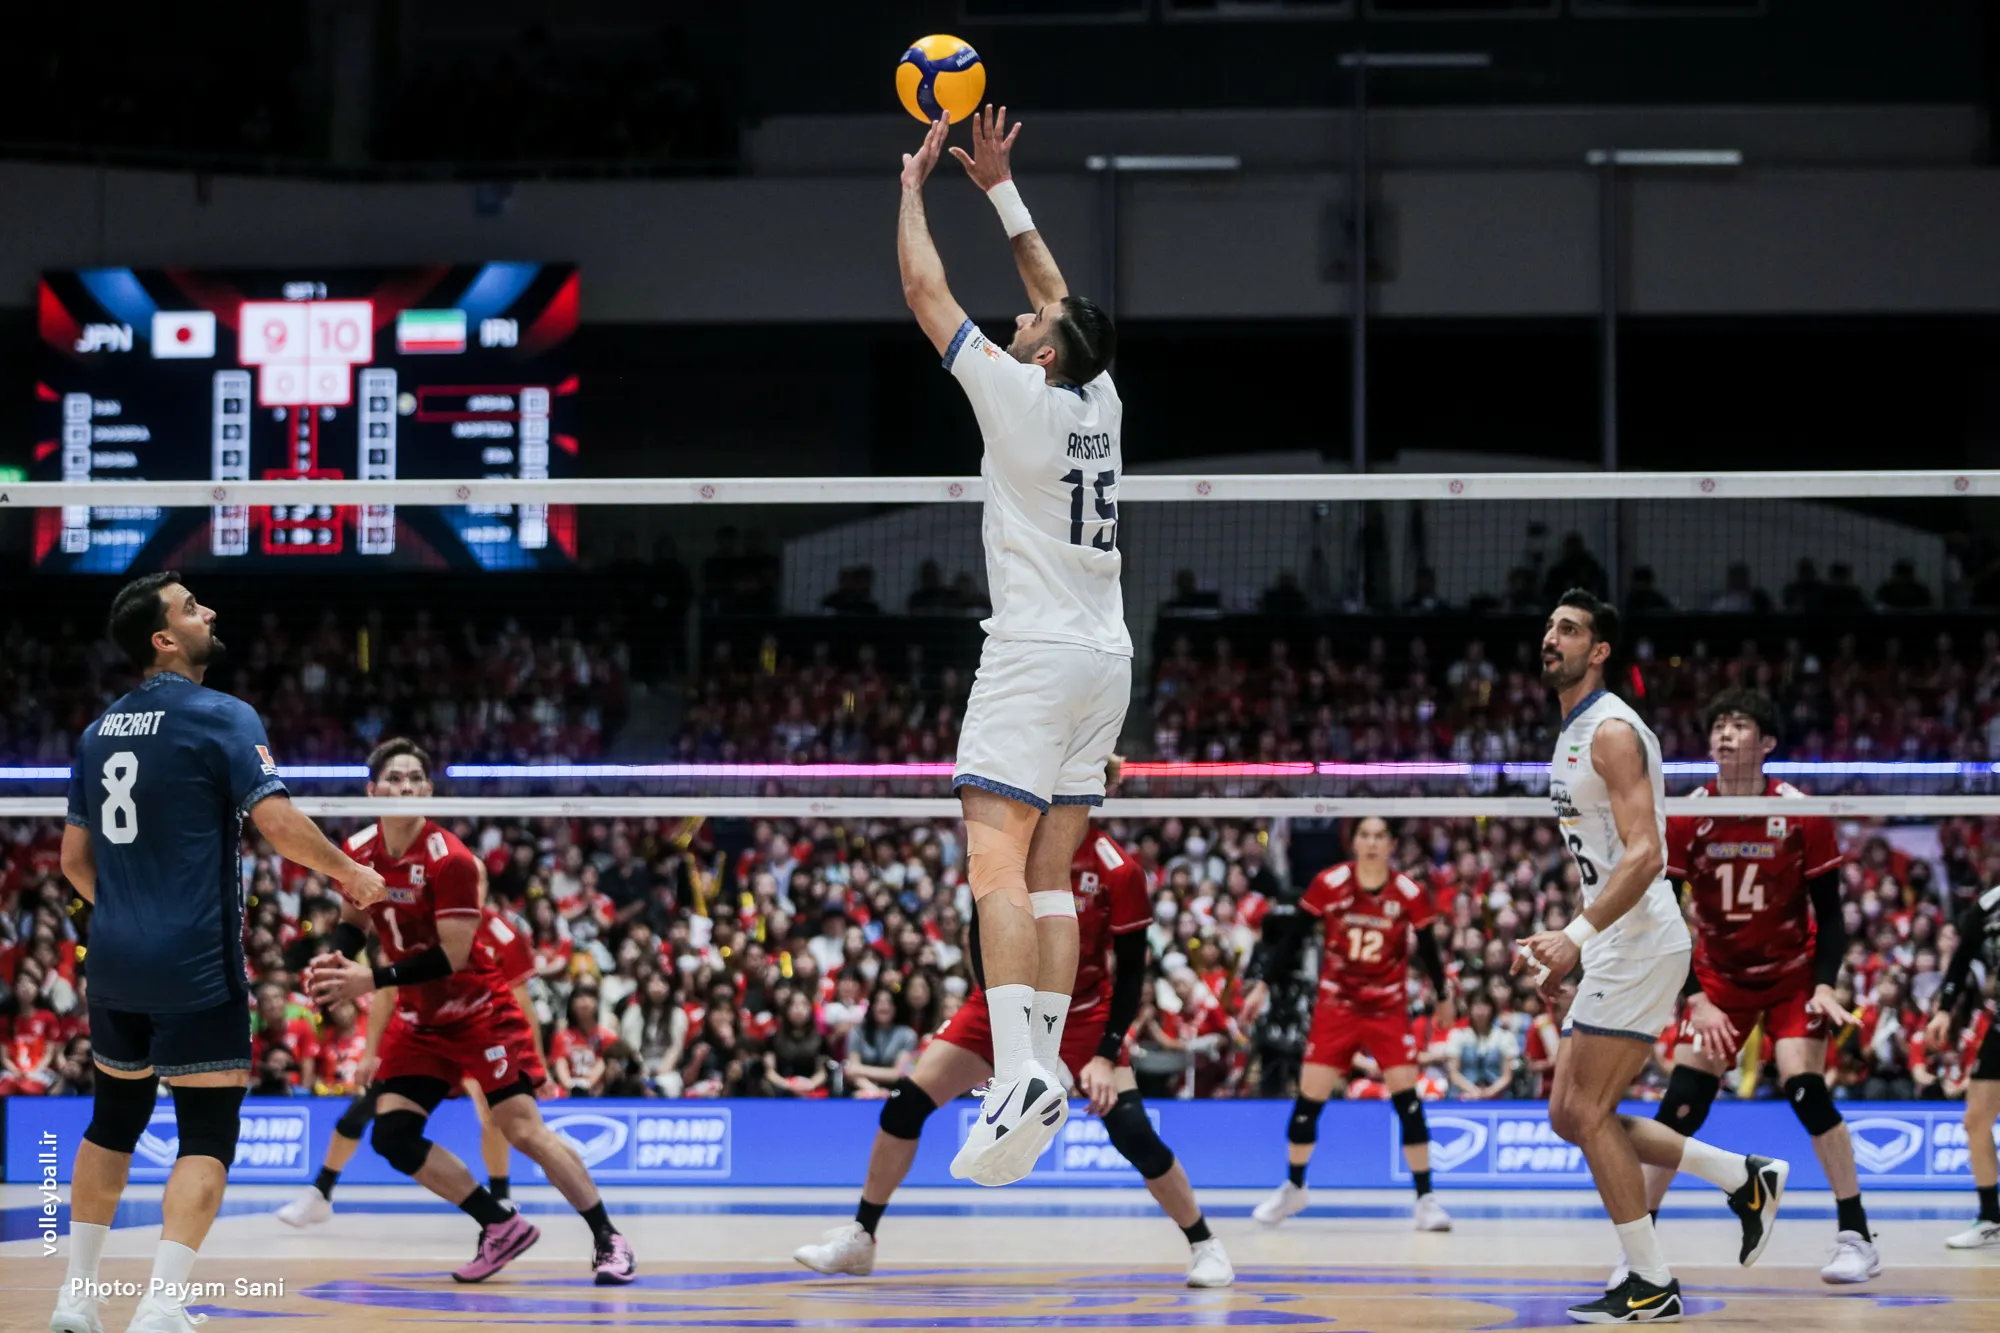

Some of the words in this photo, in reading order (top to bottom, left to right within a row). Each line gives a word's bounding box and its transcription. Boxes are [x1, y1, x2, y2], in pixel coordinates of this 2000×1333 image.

[76, 323, 133, 352] JPN
[264, 319, 288, 353] 9
[319, 319, 360, 353] 10
[98, 711, 166, 737] HAZRAT
[101, 751, 139, 845] 8
[1706, 843, 1775, 859] CAPCOM
[1714, 863, 1766, 912] 14
[383, 907, 405, 952] 1
[1347, 927, 1384, 962] 12
[239, 1117, 304, 1141] RAND
[637, 1118, 725, 1142] GRAND
[1498, 1121, 1565, 1144] GRA
[234, 1142, 302, 1166] PORT
[637, 1143, 723, 1167] SPORT
[1498, 1146, 1582, 1170] SPORT
